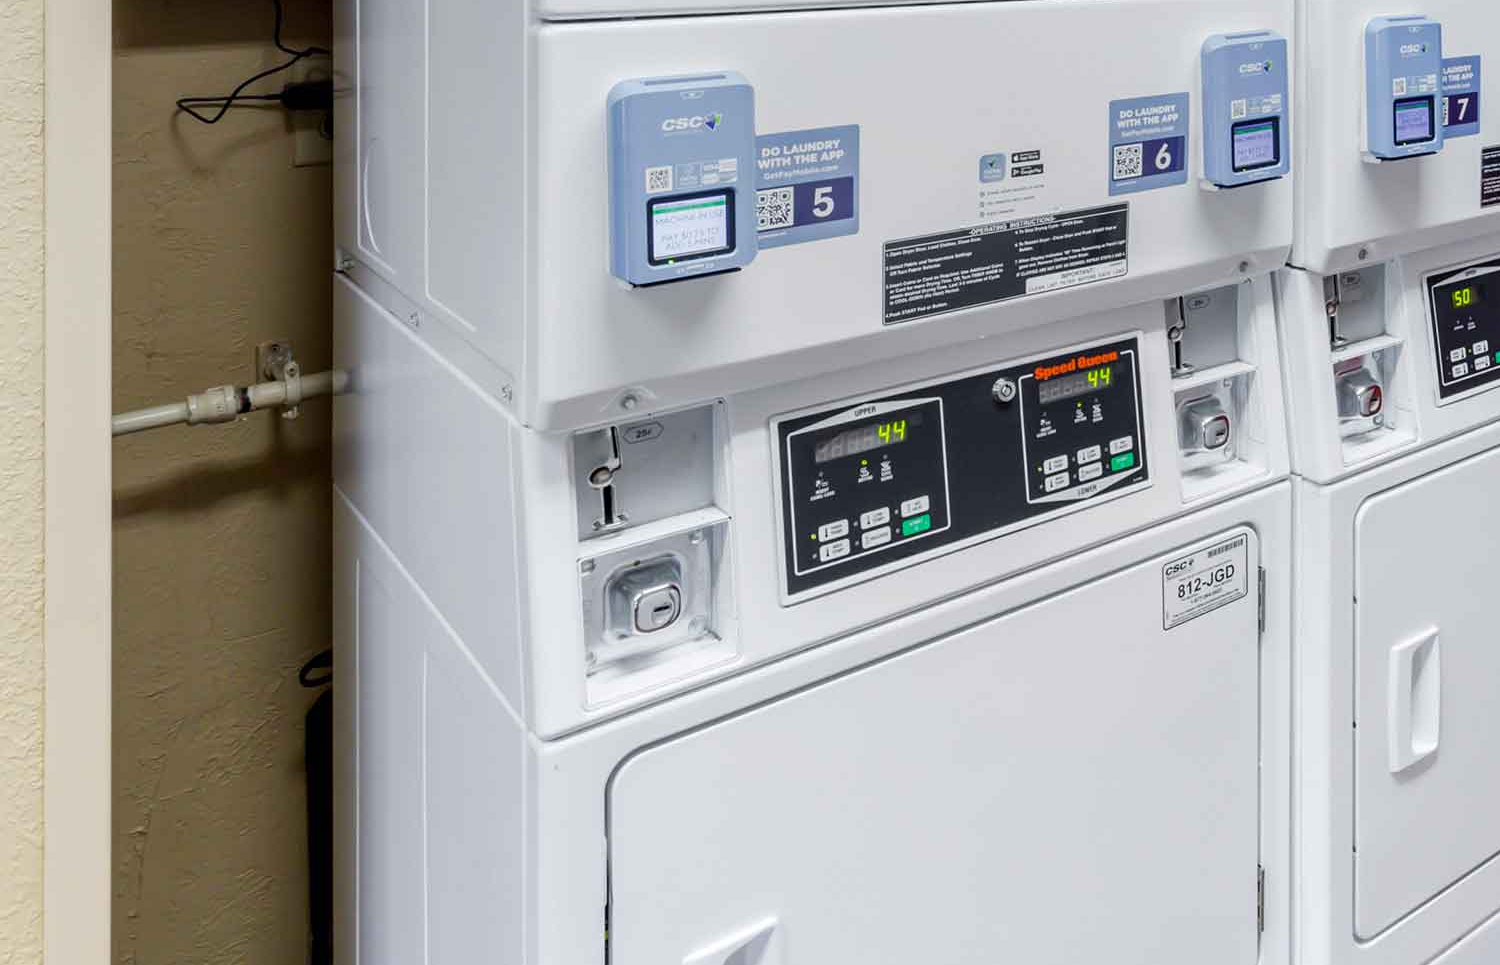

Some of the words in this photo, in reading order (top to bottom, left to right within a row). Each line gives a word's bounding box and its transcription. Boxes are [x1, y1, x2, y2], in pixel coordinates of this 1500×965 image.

[1239, 63, 1264, 74] CSC
[1120, 110, 1134, 120] DO
[1135, 104, 1177, 118] LAUNDRY
[1457, 98, 1469, 121] 7
[662, 116, 703, 131] CSC
[1117, 119, 1143, 129] WITH
[1144, 116, 1161, 126] THE
[1162, 113, 1179, 123] APP
[762, 147, 780, 157] DO
[784, 139, 841, 155] LAUNDRY
[1155, 143, 1171, 170] 6
[758, 156, 792, 170] WITH
[795, 152, 818, 165] THE
[820, 148, 845, 162] APP
[812, 186, 835, 218] 5
[1454, 288, 1471, 307] 50
[1034, 357, 1077, 380] Speed
[1077, 351, 1118, 370] Queen
[1087, 367, 1111, 388] 44
[854, 405, 878, 417] UPPER
[877, 419, 907, 444] 44
[1165, 560, 1188, 577] CSC
[1177, 564, 1235, 598] 812-JGD
